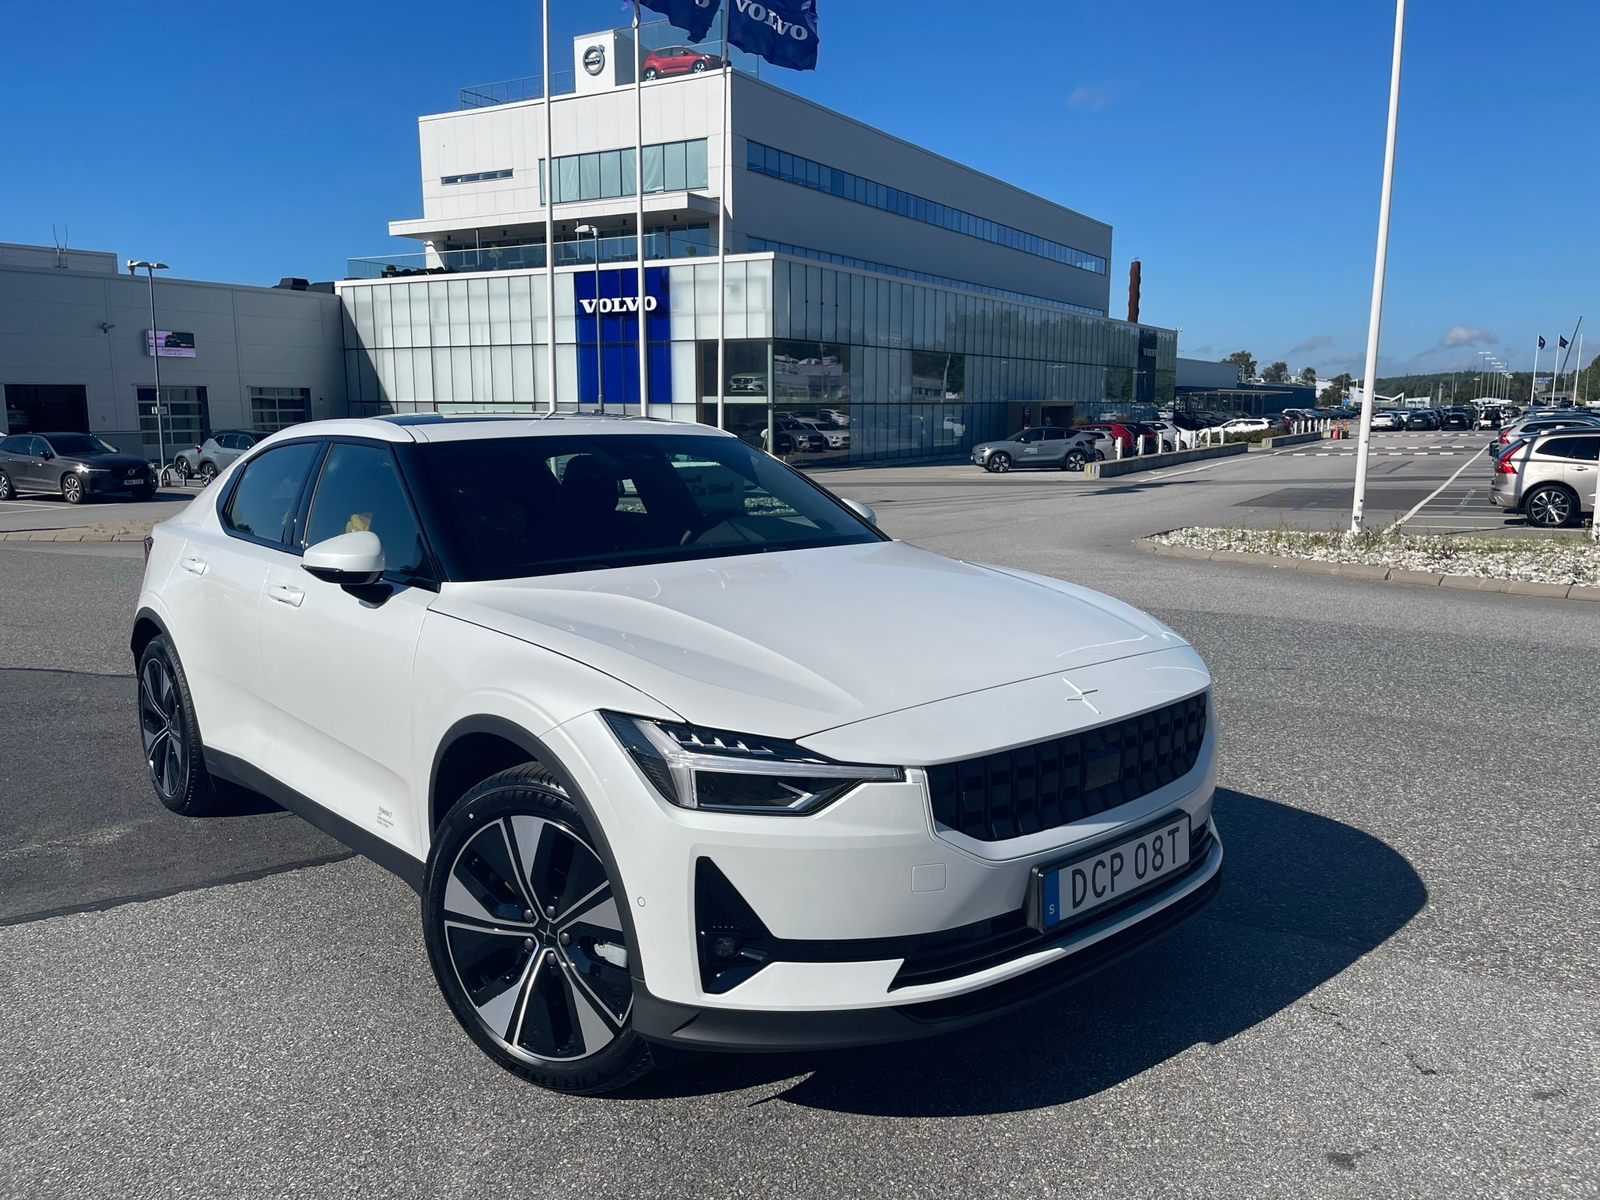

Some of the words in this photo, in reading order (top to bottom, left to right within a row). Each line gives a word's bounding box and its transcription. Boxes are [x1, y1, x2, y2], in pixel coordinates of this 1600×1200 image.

[735, 0, 808, 40] VOLVO
[579, 296, 657, 313] VOLVO
[1071, 852, 1124, 909] DCP
[1134, 826, 1180, 880] 08T
[1048, 903, 1055, 915] S
